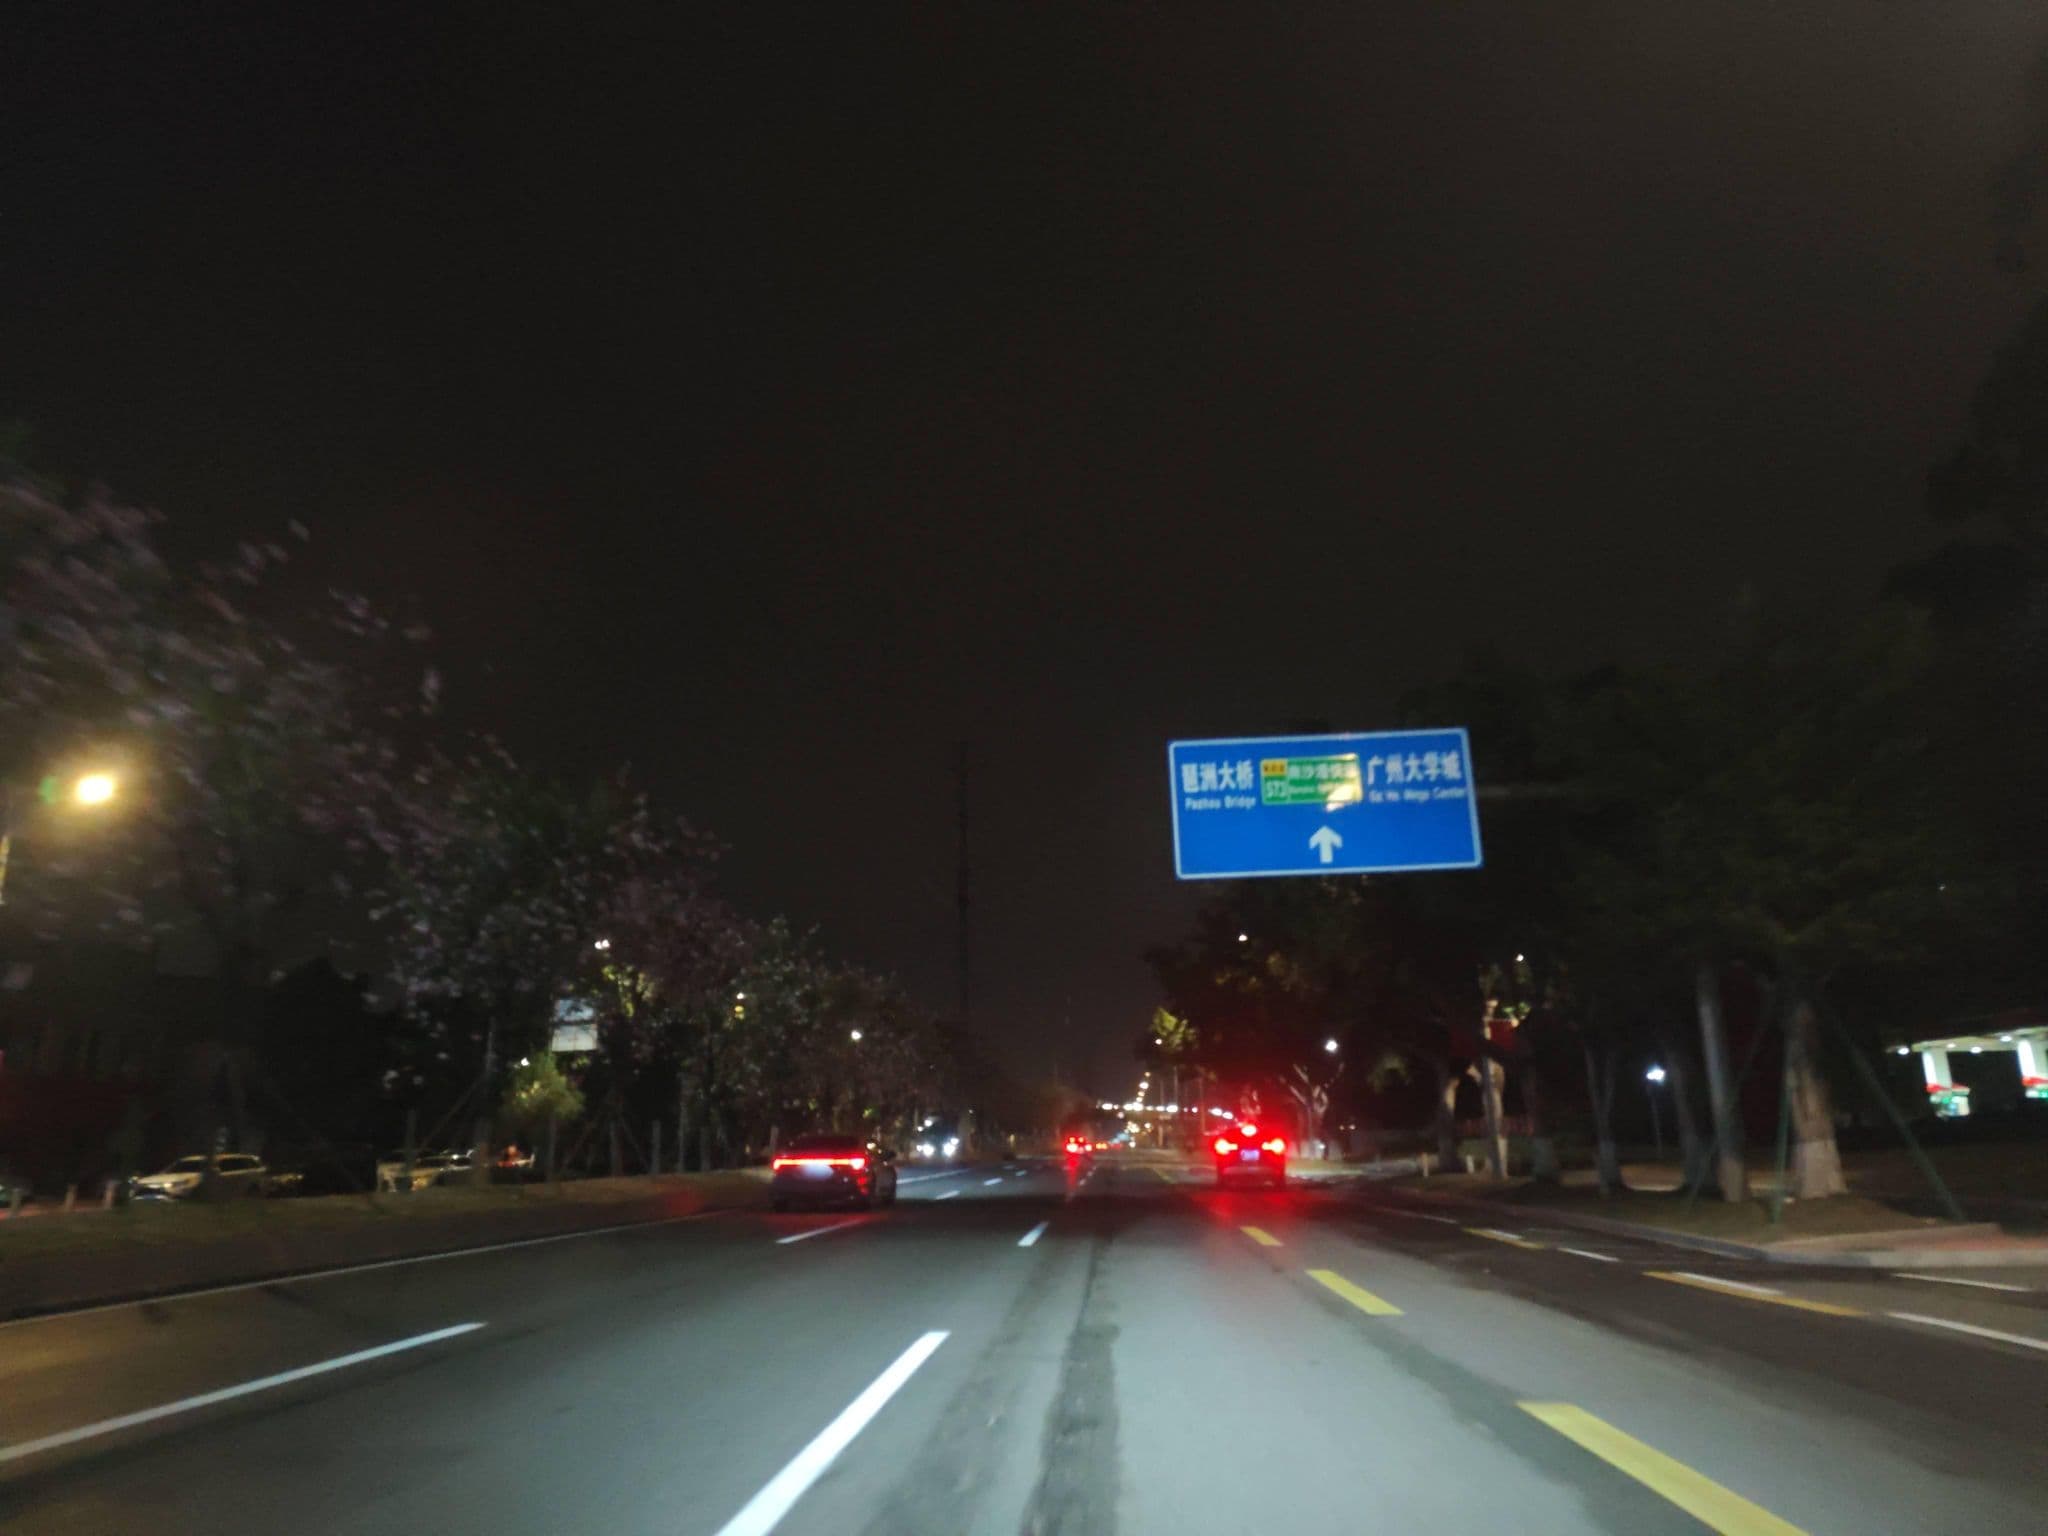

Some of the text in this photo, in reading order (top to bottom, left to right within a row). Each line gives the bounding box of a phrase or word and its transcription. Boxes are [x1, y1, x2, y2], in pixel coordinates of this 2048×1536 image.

[1367, 750, 1462, 785] 广州大学城
